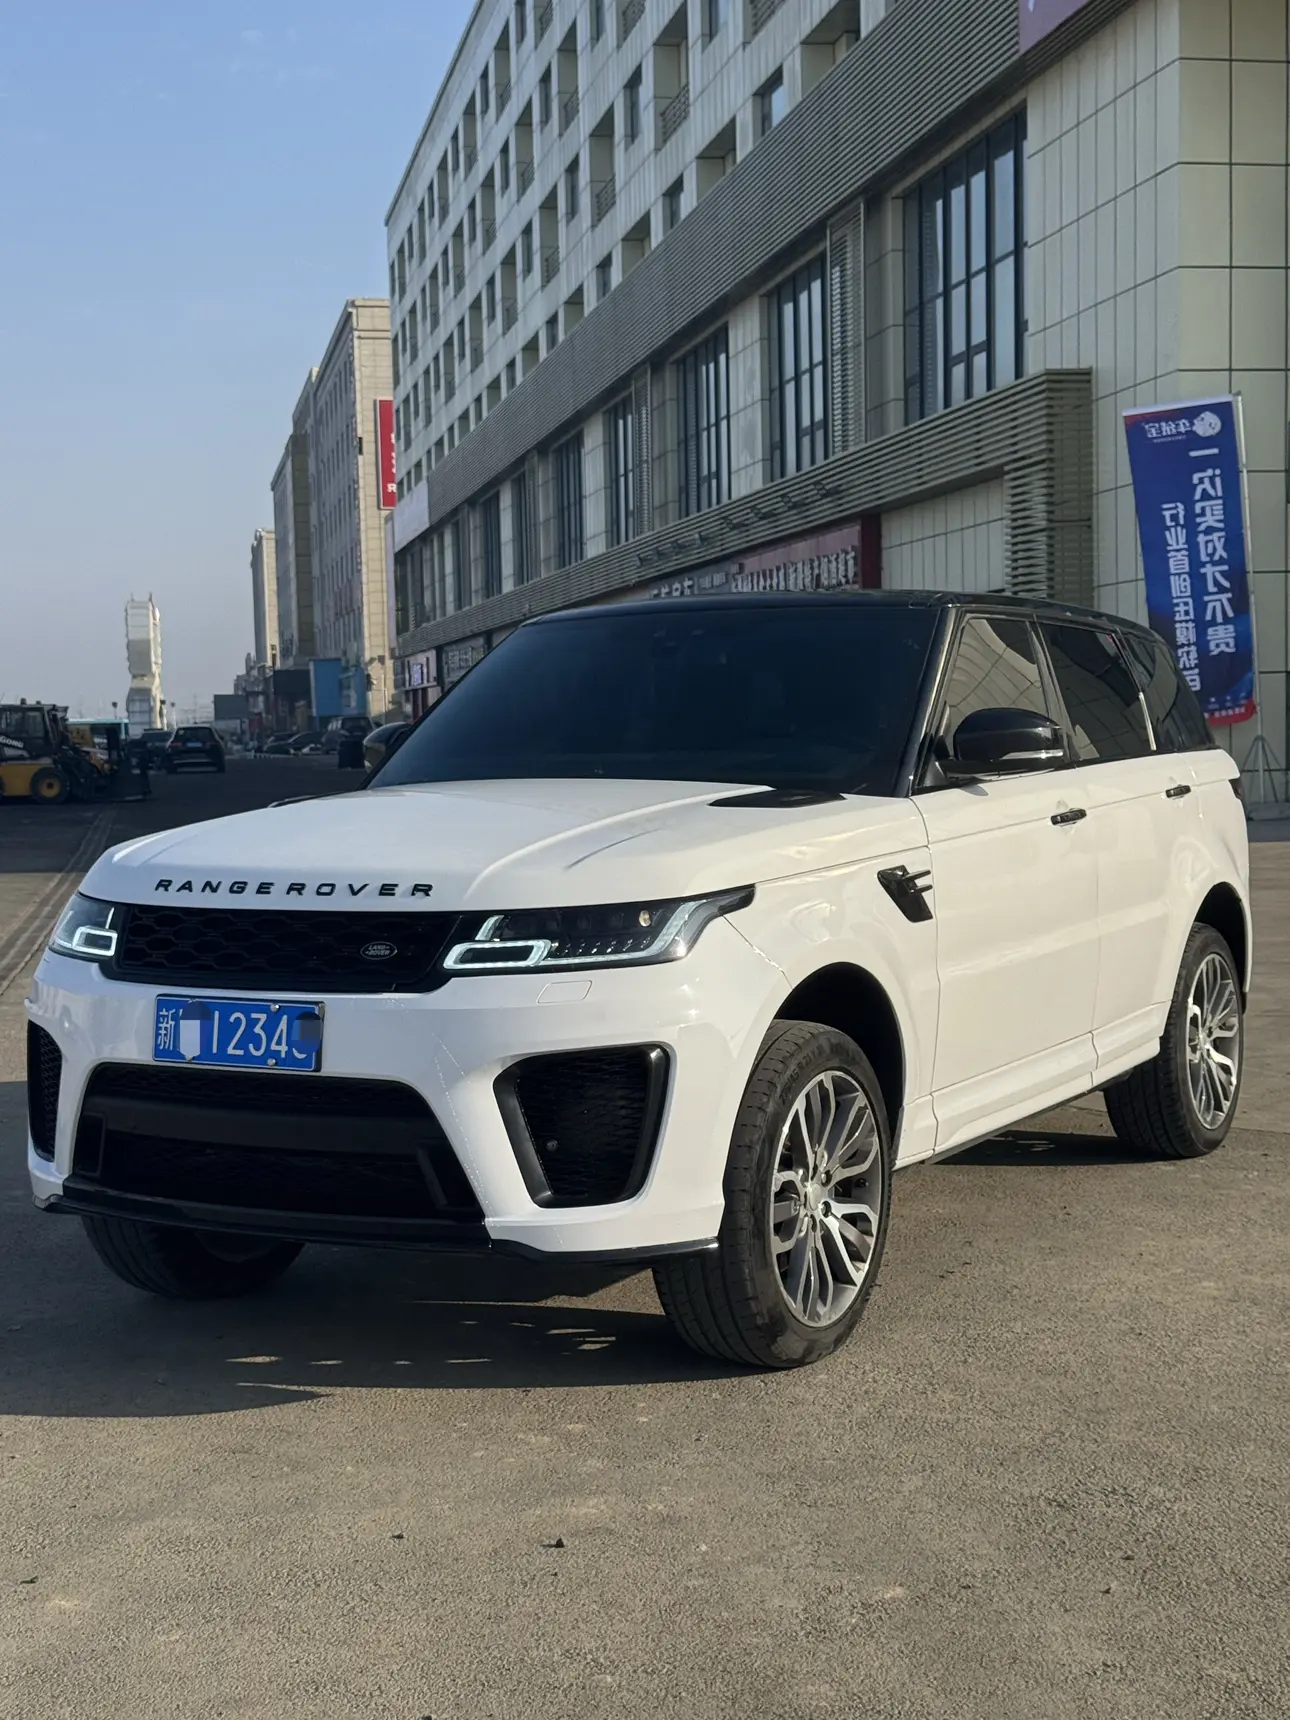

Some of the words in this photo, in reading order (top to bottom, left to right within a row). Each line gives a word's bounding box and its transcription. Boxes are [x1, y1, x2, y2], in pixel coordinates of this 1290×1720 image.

[154, 879, 275, 895] RANGE
[285, 882, 434, 897] ROVER
[157, 1007, 314, 1060] 新1234
